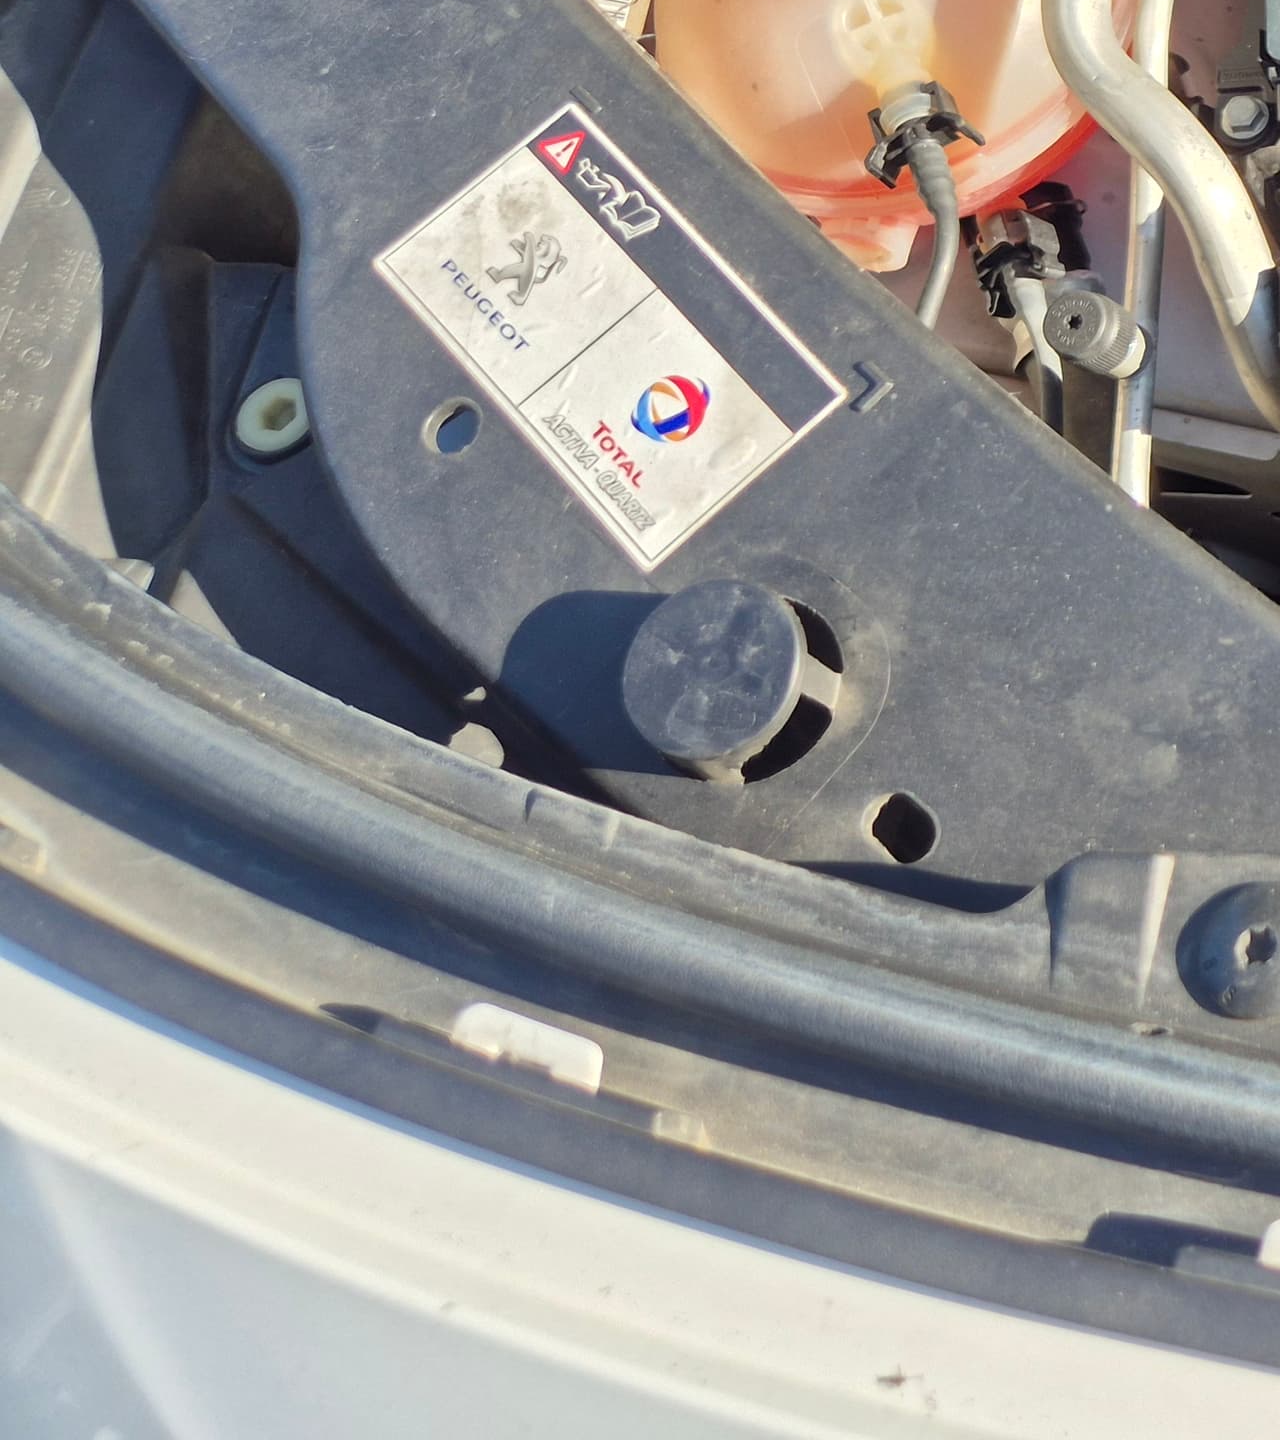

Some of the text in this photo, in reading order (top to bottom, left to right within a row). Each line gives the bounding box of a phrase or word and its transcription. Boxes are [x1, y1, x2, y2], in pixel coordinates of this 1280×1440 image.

[439, 257, 530, 352] PEUGEOT
[541, 412, 596, 471] ACTIVA
[595, 469, 657, 533] QUARTZ
[592, 420, 642, 490] TOTAL
